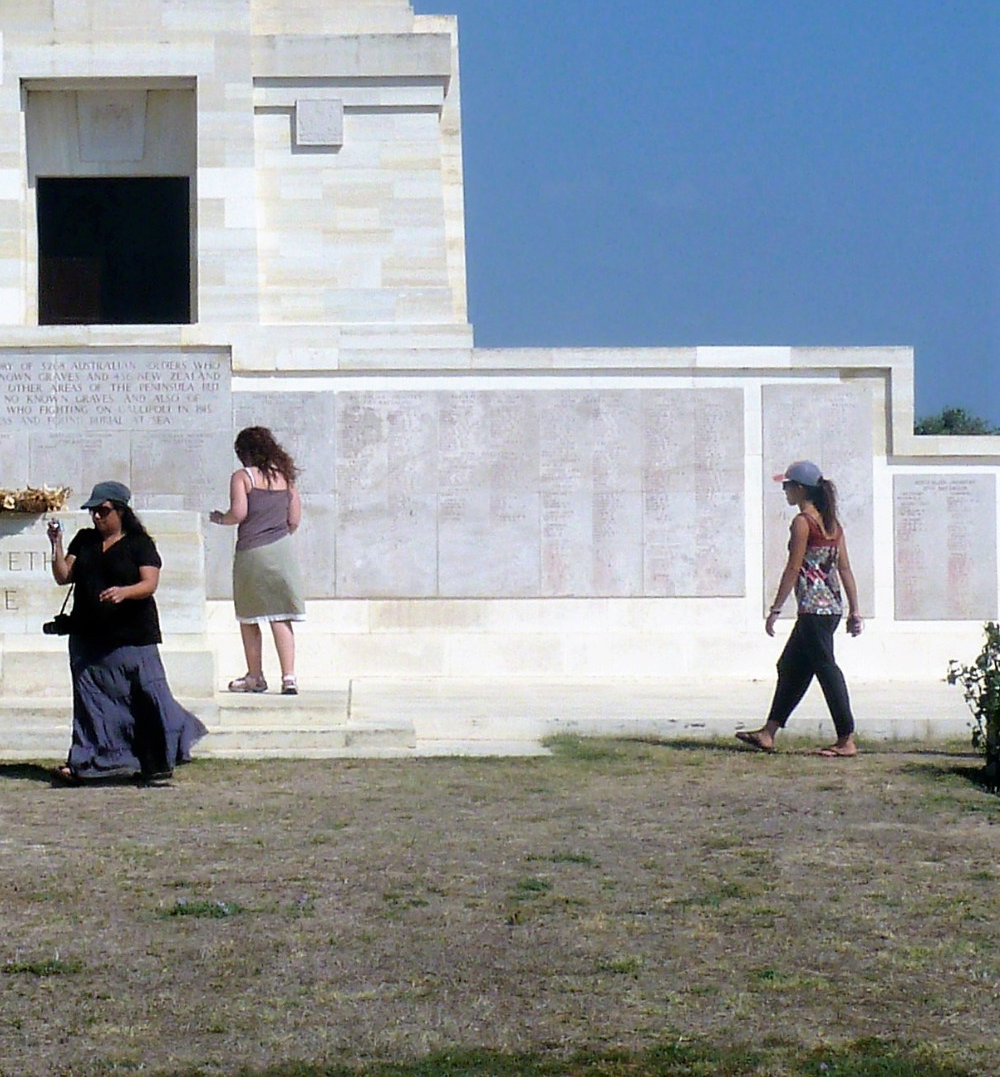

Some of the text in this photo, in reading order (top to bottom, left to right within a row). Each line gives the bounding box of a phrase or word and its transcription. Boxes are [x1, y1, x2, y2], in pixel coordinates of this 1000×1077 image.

[20, 362, 33, 371] OF
[72, 361, 136, 371] AUSTRALIAN
[193, 361, 221, 370] WHO
[38, 372, 80, 382] GRAVES
[87, 372, 110, 381] AND
[170, 371, 221, 381] ZEALAND
[8, 383, 43, 393] OTHER
[51, 383, 83, 393] AREAS
[110, 383, 131, 392] THE
[138, 382, 195, 392] PENINSULA
[4, 394, 20, 403] NO
[26, 394, 70, 403] KNOWN
[75, 394, 115, 403] GRAVES
[125, 394, 147, 403] AND
[154, 394, 181, 403] ALSO
[6, 405, 33, 415] WHO
[39, 405, 89, 415] FIGHTING
[95, 405, 112, 414] ON
[177, 404, 190, 414] IN
